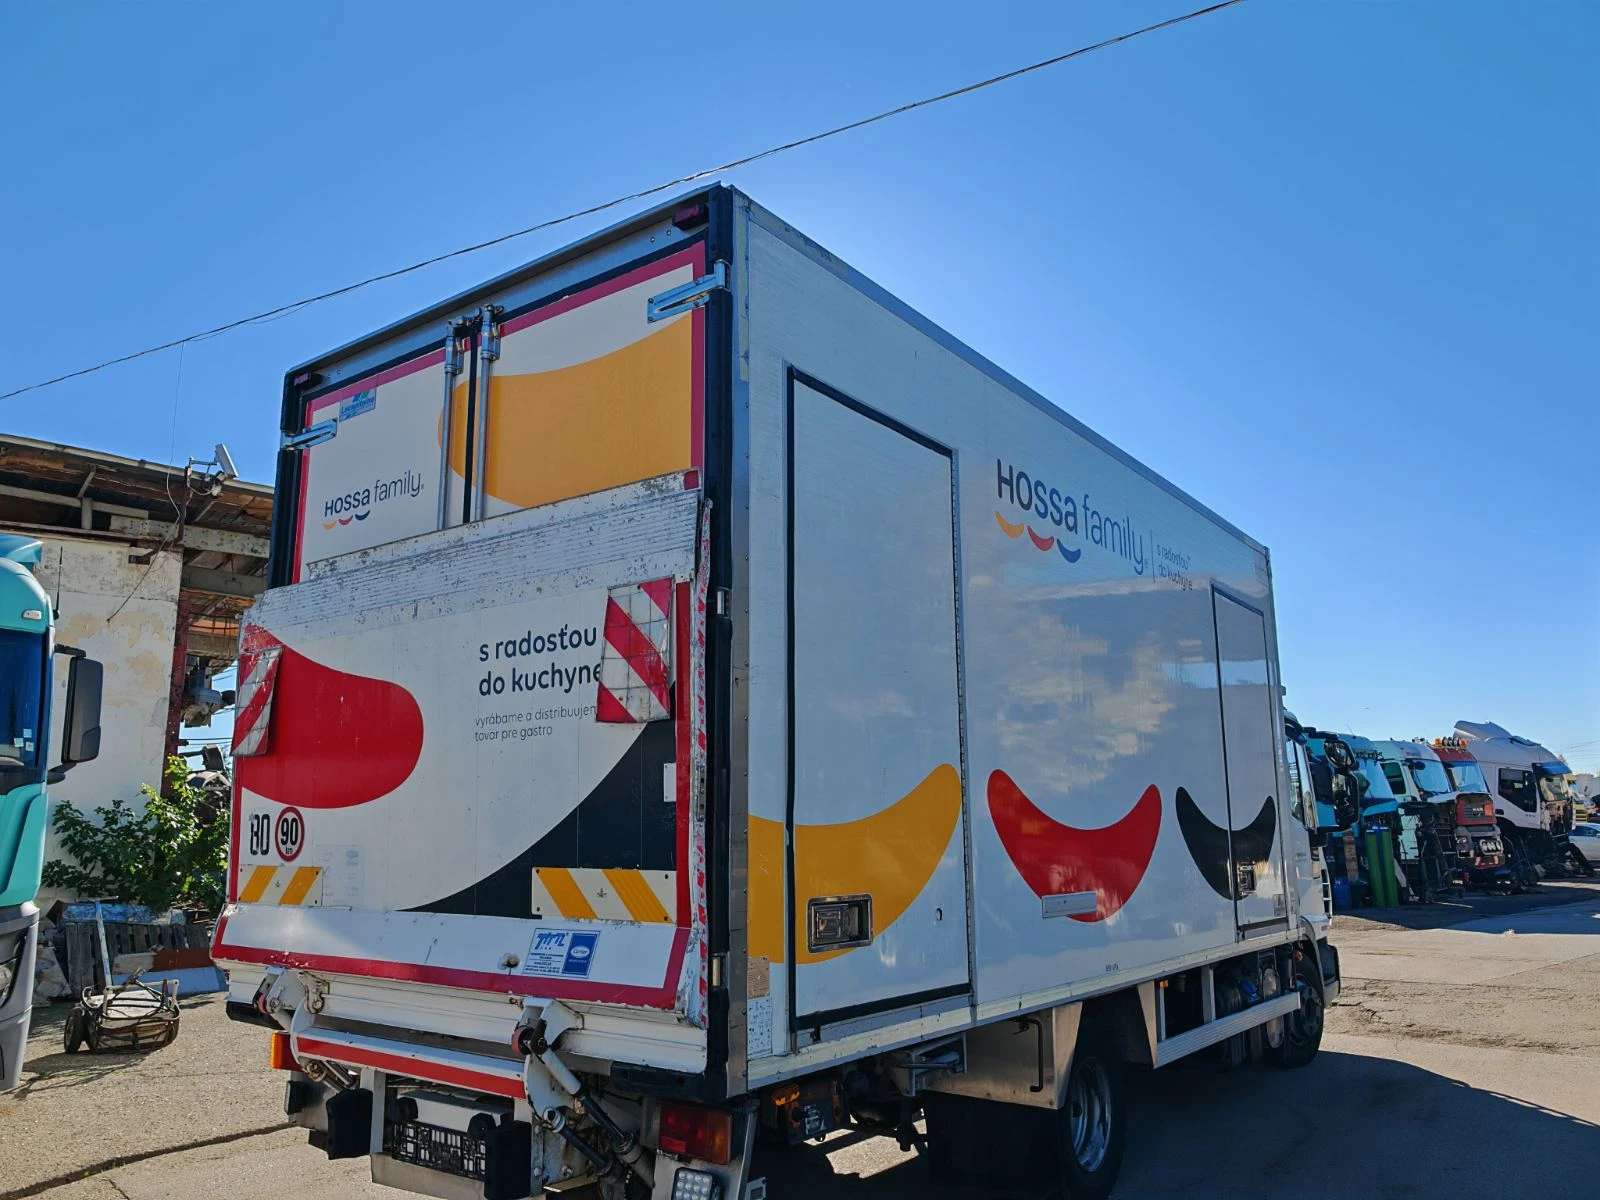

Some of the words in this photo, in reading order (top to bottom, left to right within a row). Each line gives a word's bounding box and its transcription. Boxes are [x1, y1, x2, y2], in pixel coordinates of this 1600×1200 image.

[479, 643, 489, 662] s
[495, 624, 597, 659] radosťou
[479, 671, 505, 696] do
[525, 712, 532, 721] a
[475, 730, 499, 742] tovar
[501, 728, 518, 742] pre
[519, 725, 553, 741] gastro
[280, 817, 299, 846] 90
